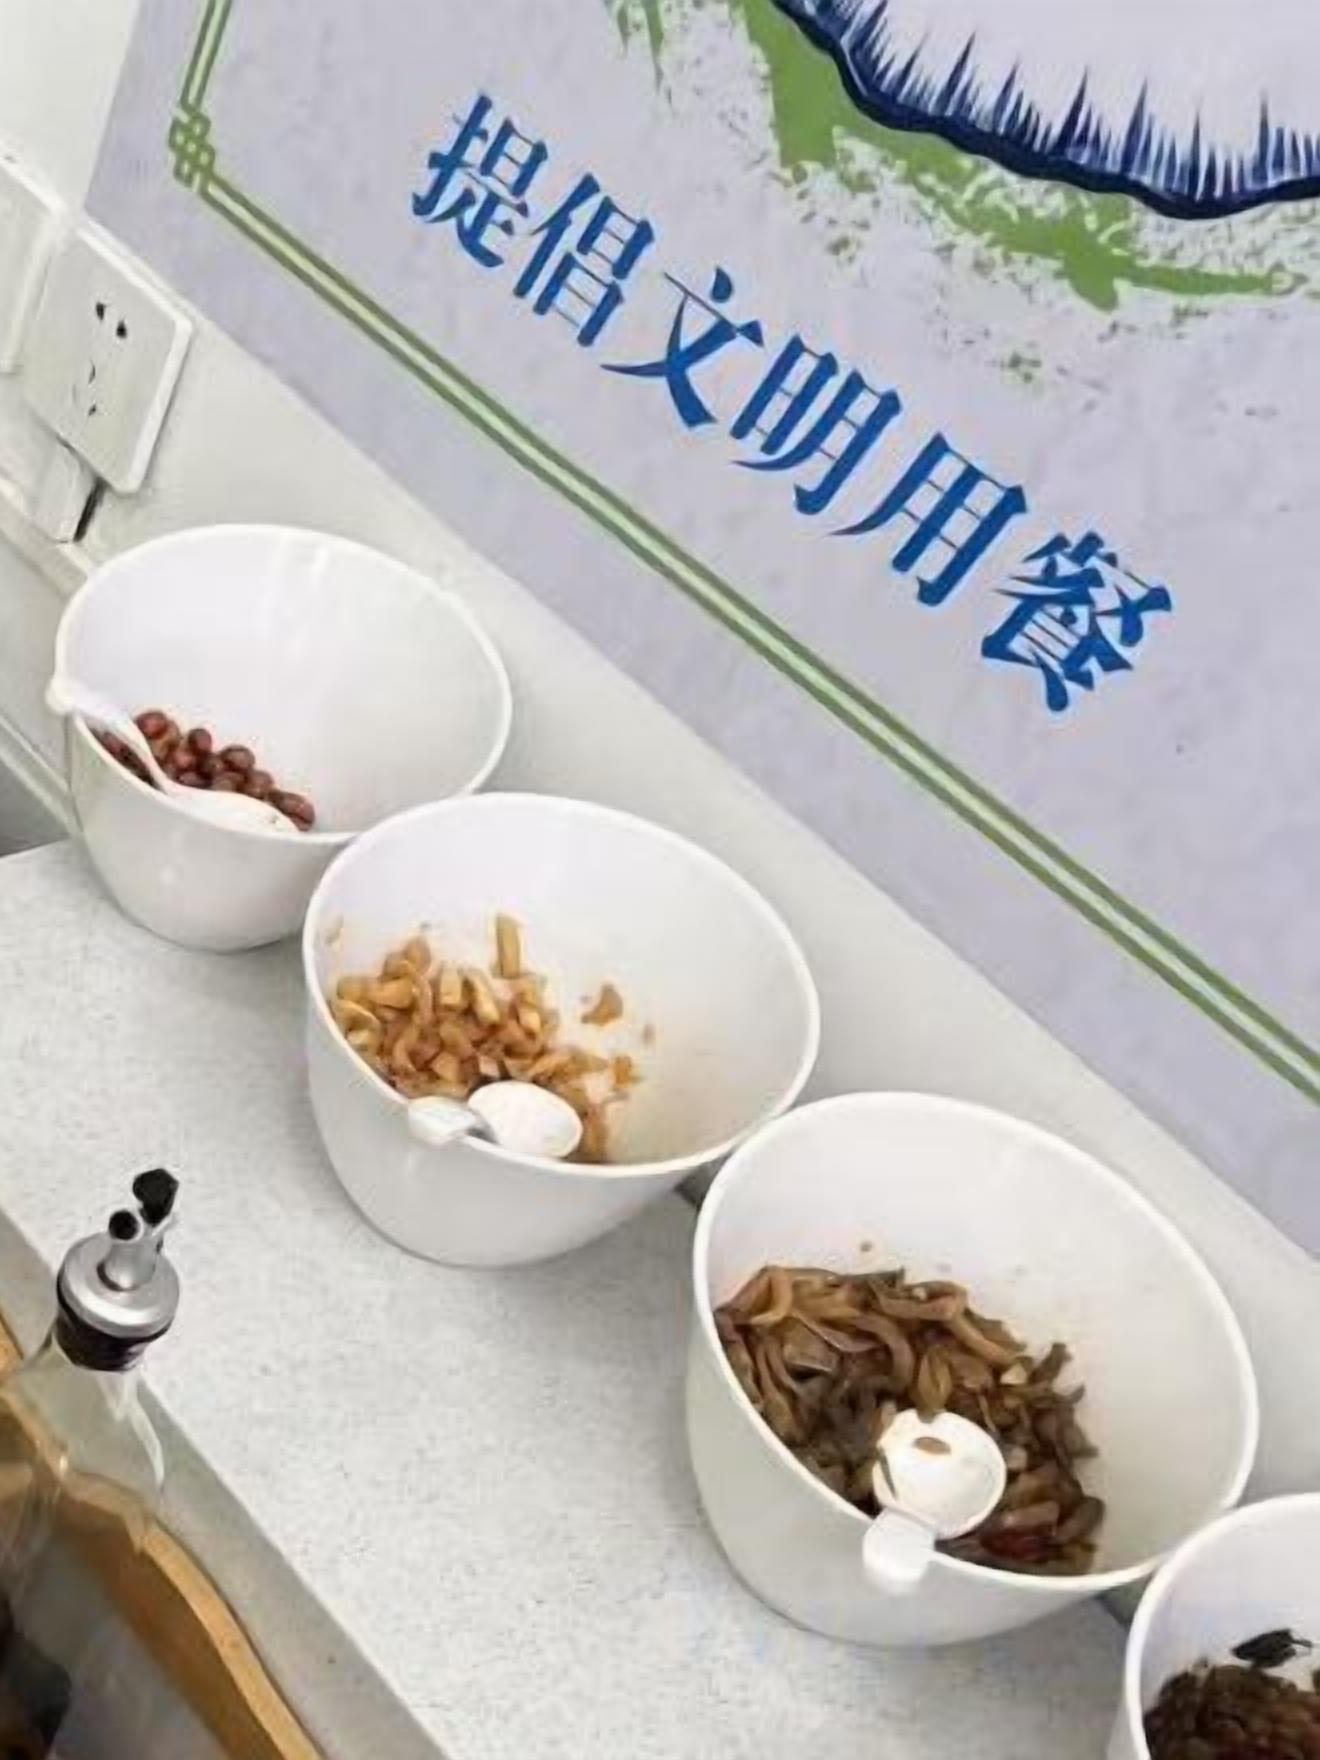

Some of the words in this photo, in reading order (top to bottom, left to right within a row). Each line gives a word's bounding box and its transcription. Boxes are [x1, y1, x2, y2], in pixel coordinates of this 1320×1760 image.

[412, 95, 1173, 712] 提倡文明用餐
